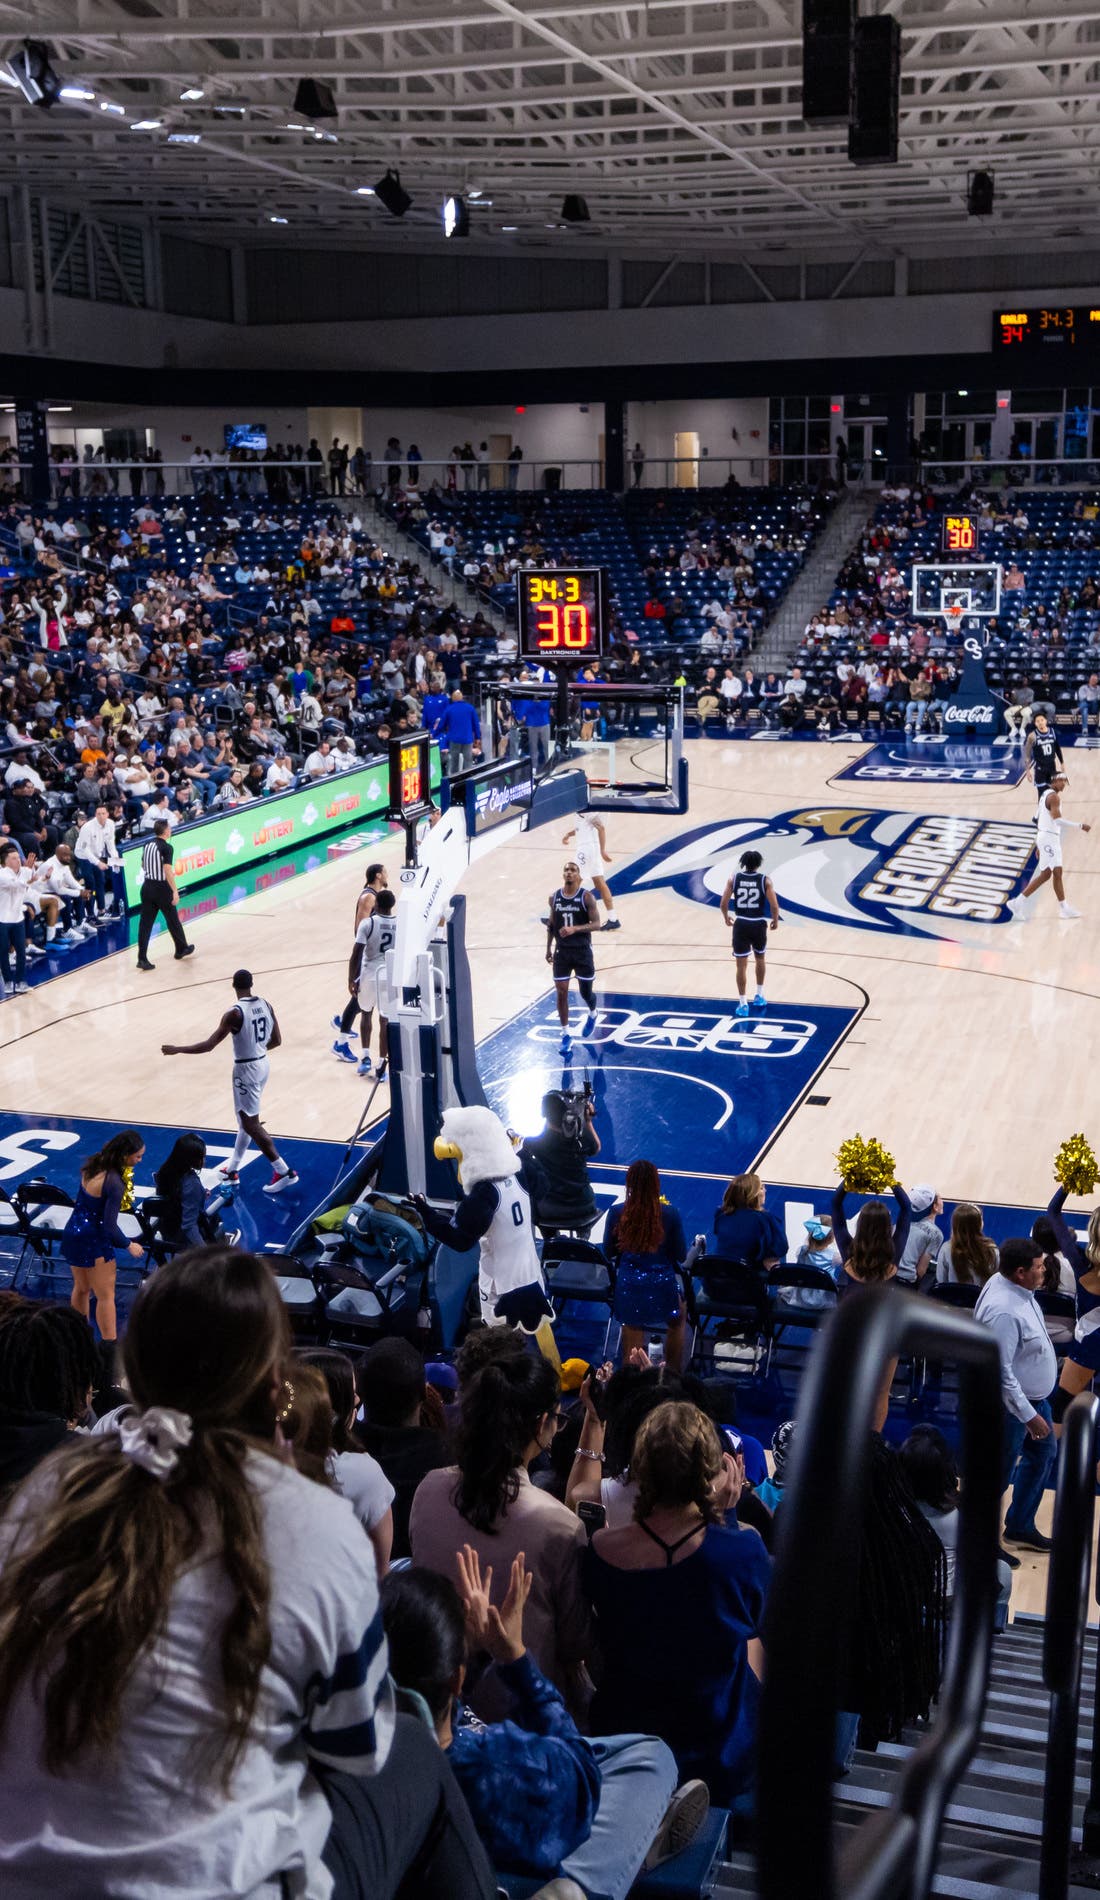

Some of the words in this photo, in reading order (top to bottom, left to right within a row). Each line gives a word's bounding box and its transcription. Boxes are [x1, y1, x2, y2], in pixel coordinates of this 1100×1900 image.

[1039, 309, 1074, 329] 34.3
[1002, 326, 1023, 345] 34
[947, 517, 970, 529] 34.3
[949, 529, 972, 547] 30
[530, 577, 579, 602] 34.3
[537, 604, 588, 648] 30
[945, 705, 995, 723] Coca-Cola
[1041, 744, 1053, 756] 10
[403, 771, 420, 803] 30
[325, 794, 361, 818] LOTTERY
[253, 818, 294, 847] LOTTERY
[173, 847, 216, 877] OTTERY
[858, 817, 982, 907] GEORGIA
[928, 821, 1038, 919] SOUTHERN
[737, 888, 760, 909] 22
[561, 913, 574, 928] 11
[379, 932, 393, 954] 2
[252, 1016, 267, 1043] 13
[511, 1201, 524, 1227] 0
